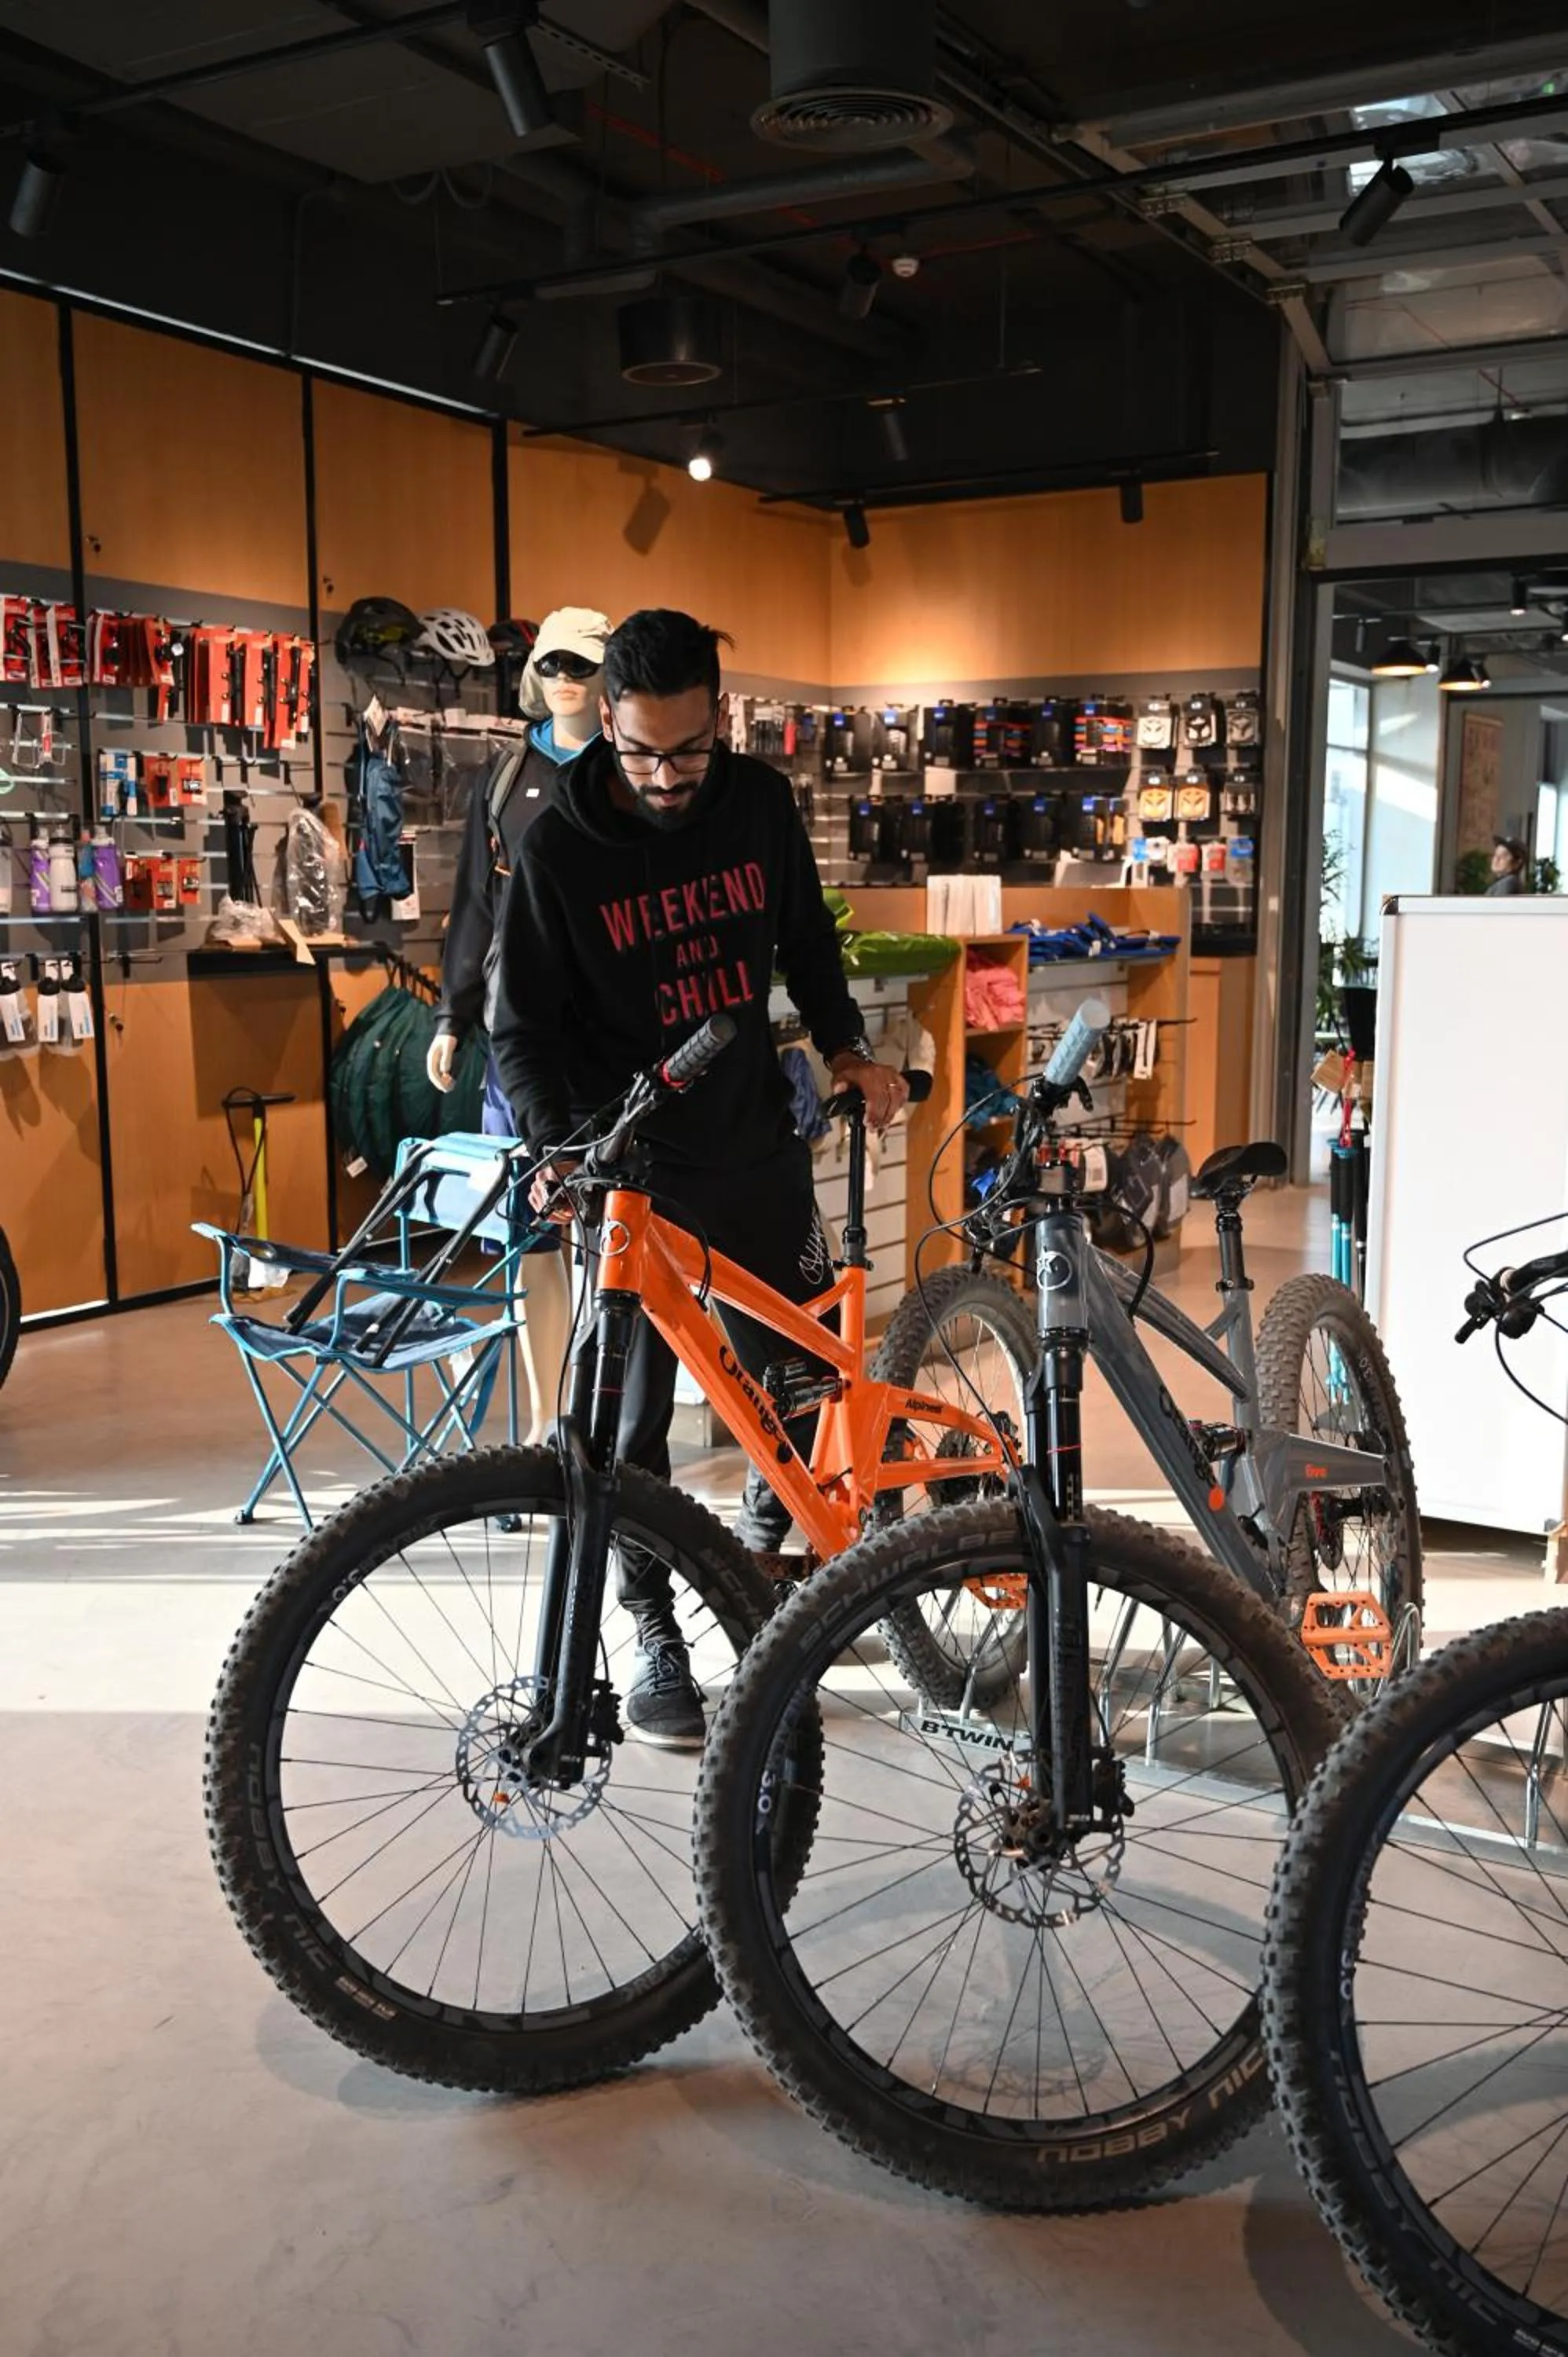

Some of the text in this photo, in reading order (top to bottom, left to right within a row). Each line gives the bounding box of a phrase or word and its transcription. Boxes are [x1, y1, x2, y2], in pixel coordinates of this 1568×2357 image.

[599, 862, 766, 952] WEEKEND
[676, 935, 720, 968] AND
[658, 960, 754, 1026] CHILL
